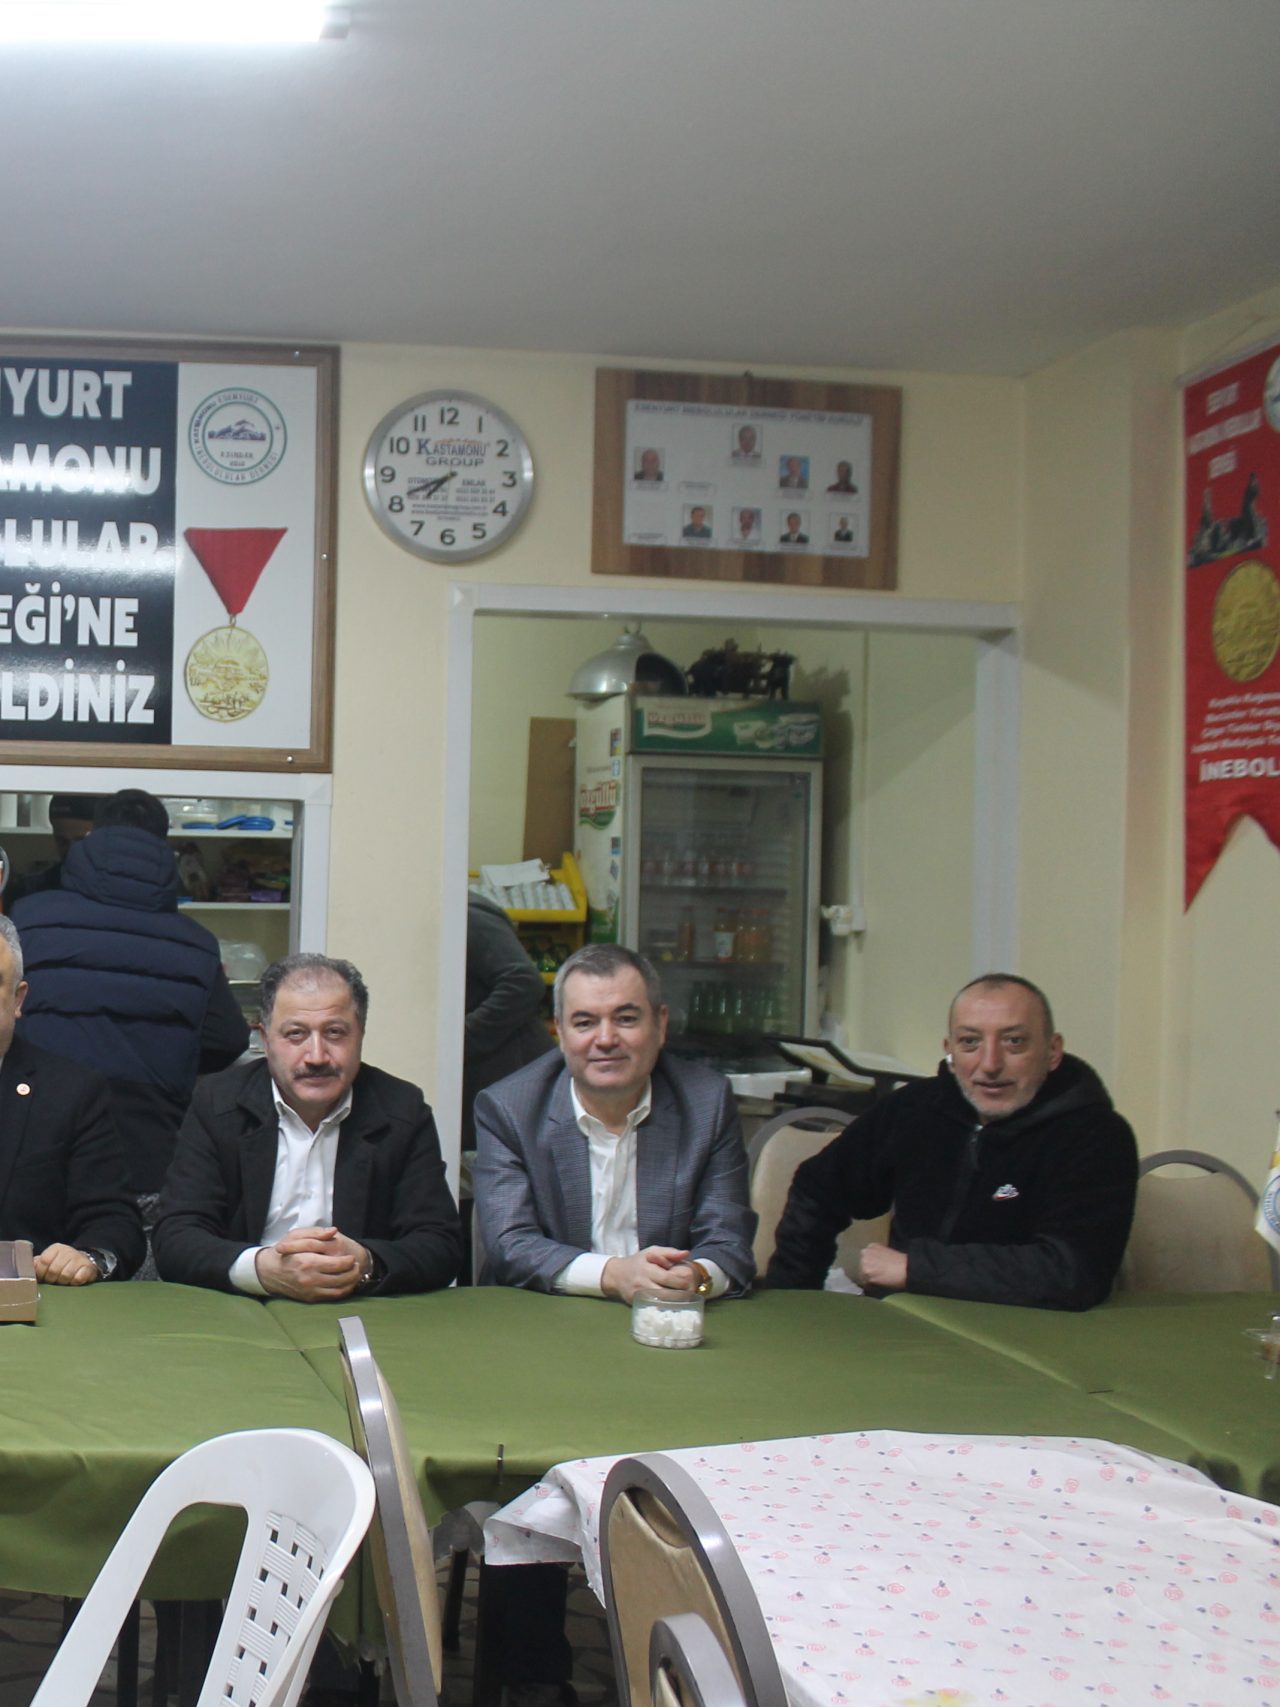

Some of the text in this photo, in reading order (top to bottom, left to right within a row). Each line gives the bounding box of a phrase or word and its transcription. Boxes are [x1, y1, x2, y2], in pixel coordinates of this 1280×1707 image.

[414, 415, 427, 432] 11
[440, 407, 459, 425] 12
[389, 437, 411, 454] 10
[496, 439, 509, 457] 2
[425, 456, 485, 467] GROUP
[380, 466, 396, 483] 9
[502, 471, 517, 488] 3
[388, 496, 404, 513] 8
[492, 501, 508, 517] 4
[410, 520, 425, 537] 7
[440, 529, 456, 545] 6
[472, 522, 487, 539] 5
